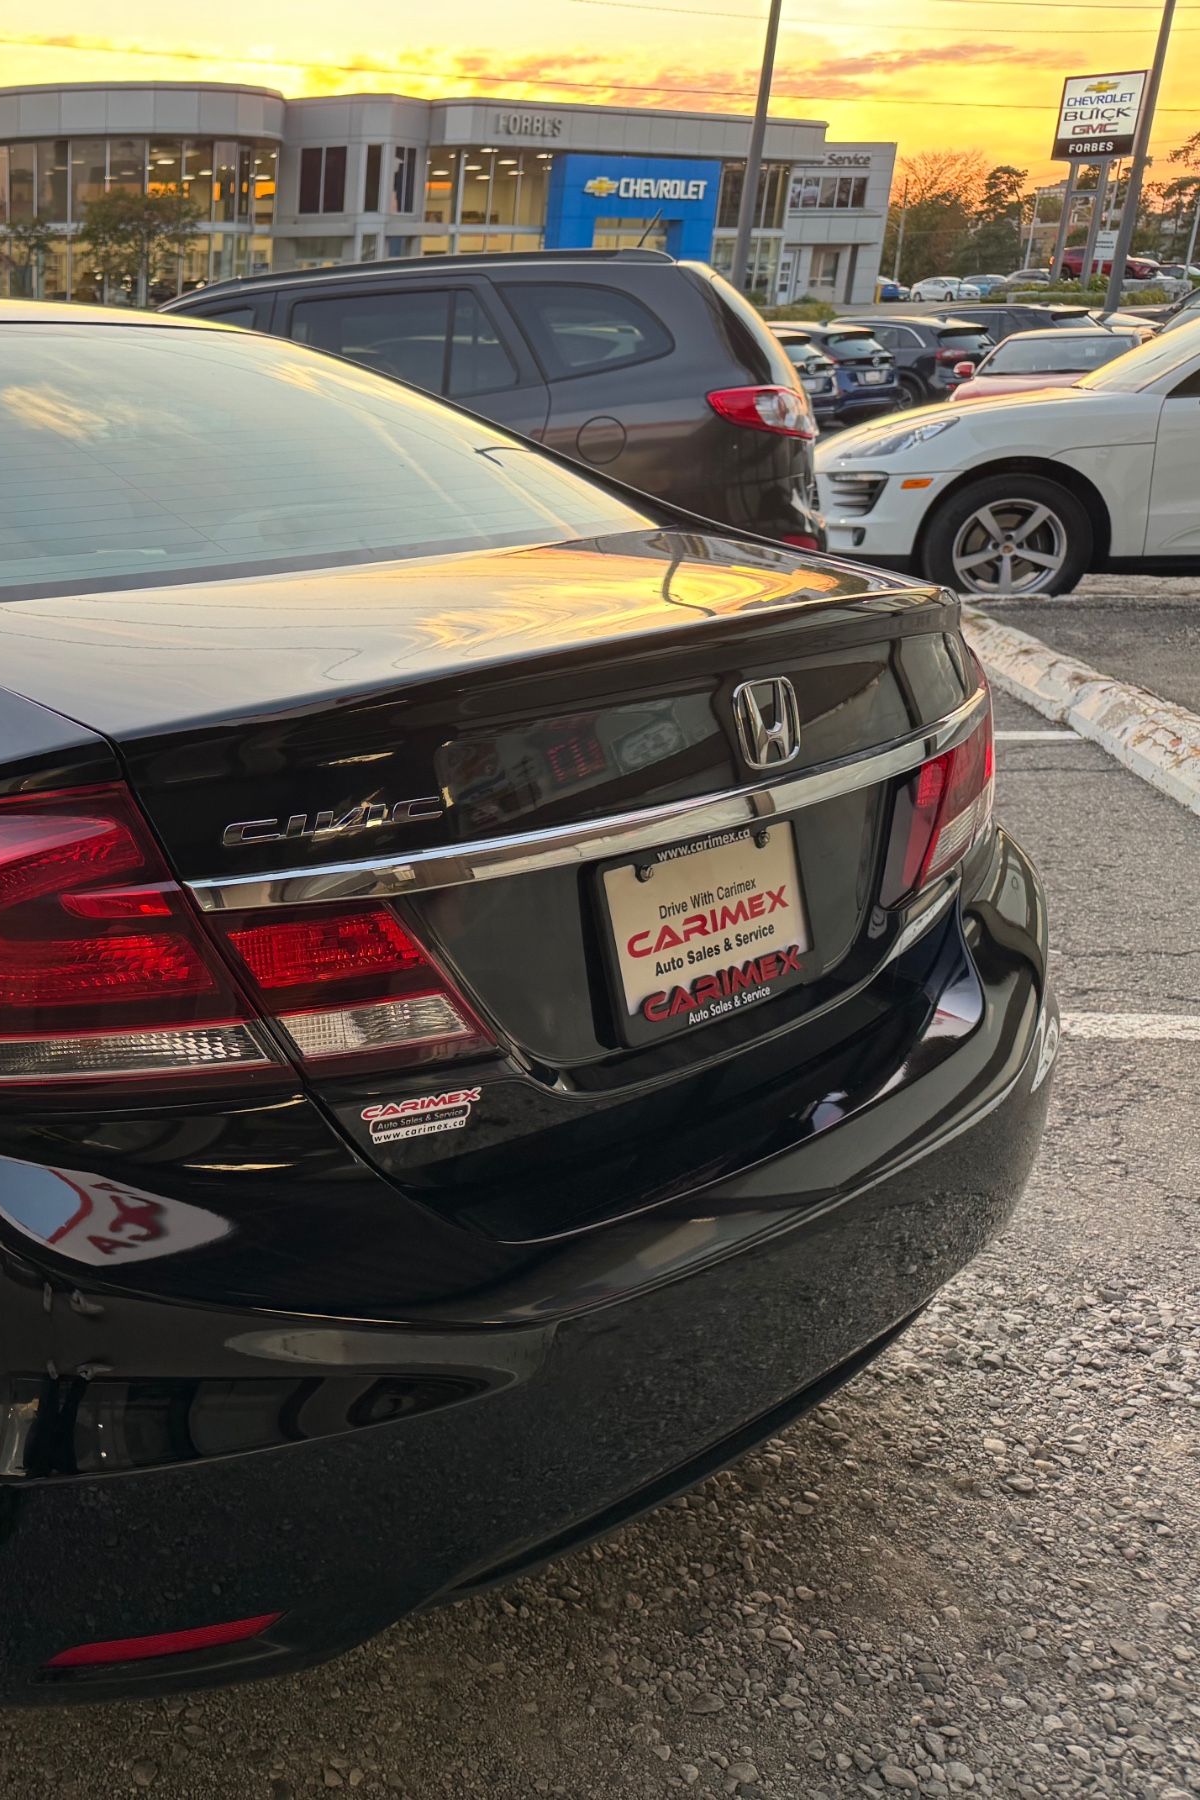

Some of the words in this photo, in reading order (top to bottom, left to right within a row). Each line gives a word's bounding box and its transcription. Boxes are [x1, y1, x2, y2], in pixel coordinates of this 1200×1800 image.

[1066, 92, 1135, 107] CHEVROLET
[496, 113, 563, 137] FORBES
[1063, 107, 1132, 121] BUICK
[1071, 122, 1119, 135] GMC
[1068, 141, 1114, 153] FORBES
[827, 153, 871, 166] Service
[618, 177, 708, 200] CHEVROLET
[222, 796, 444, 847] CIVIC
[656, 829, 751, 862] www.carimex.ca
[658, 900, 688, 919] Drive
[690, 890, 715, 911] With
[717, 878, 757, 900] Carimex
[627, 885, 789, 958] CARIMEX
[655, 957, 684, 976] Auto
[687, 943, 721, 965] Sales
[724, 937, 733, 952] &
[736, 924, 775, 947] Service
[643, 944, 803, 1022] CARIMEX
[688, 1010, 709, 1025] Auto
[710, 1000, 732, 1016] Sales
[734, 995, 741, 1007] &
[742, 986, 771, 1004] Service
[362, 1089, 481, 1119] CARIMEX
[374, 1120, 465, 1143] www.carimex.ca
[377, 1122, 398, 1131] Auto
[401, 1116, 423, 1126] Sales
[434, 1108, 464, 1119] Service
